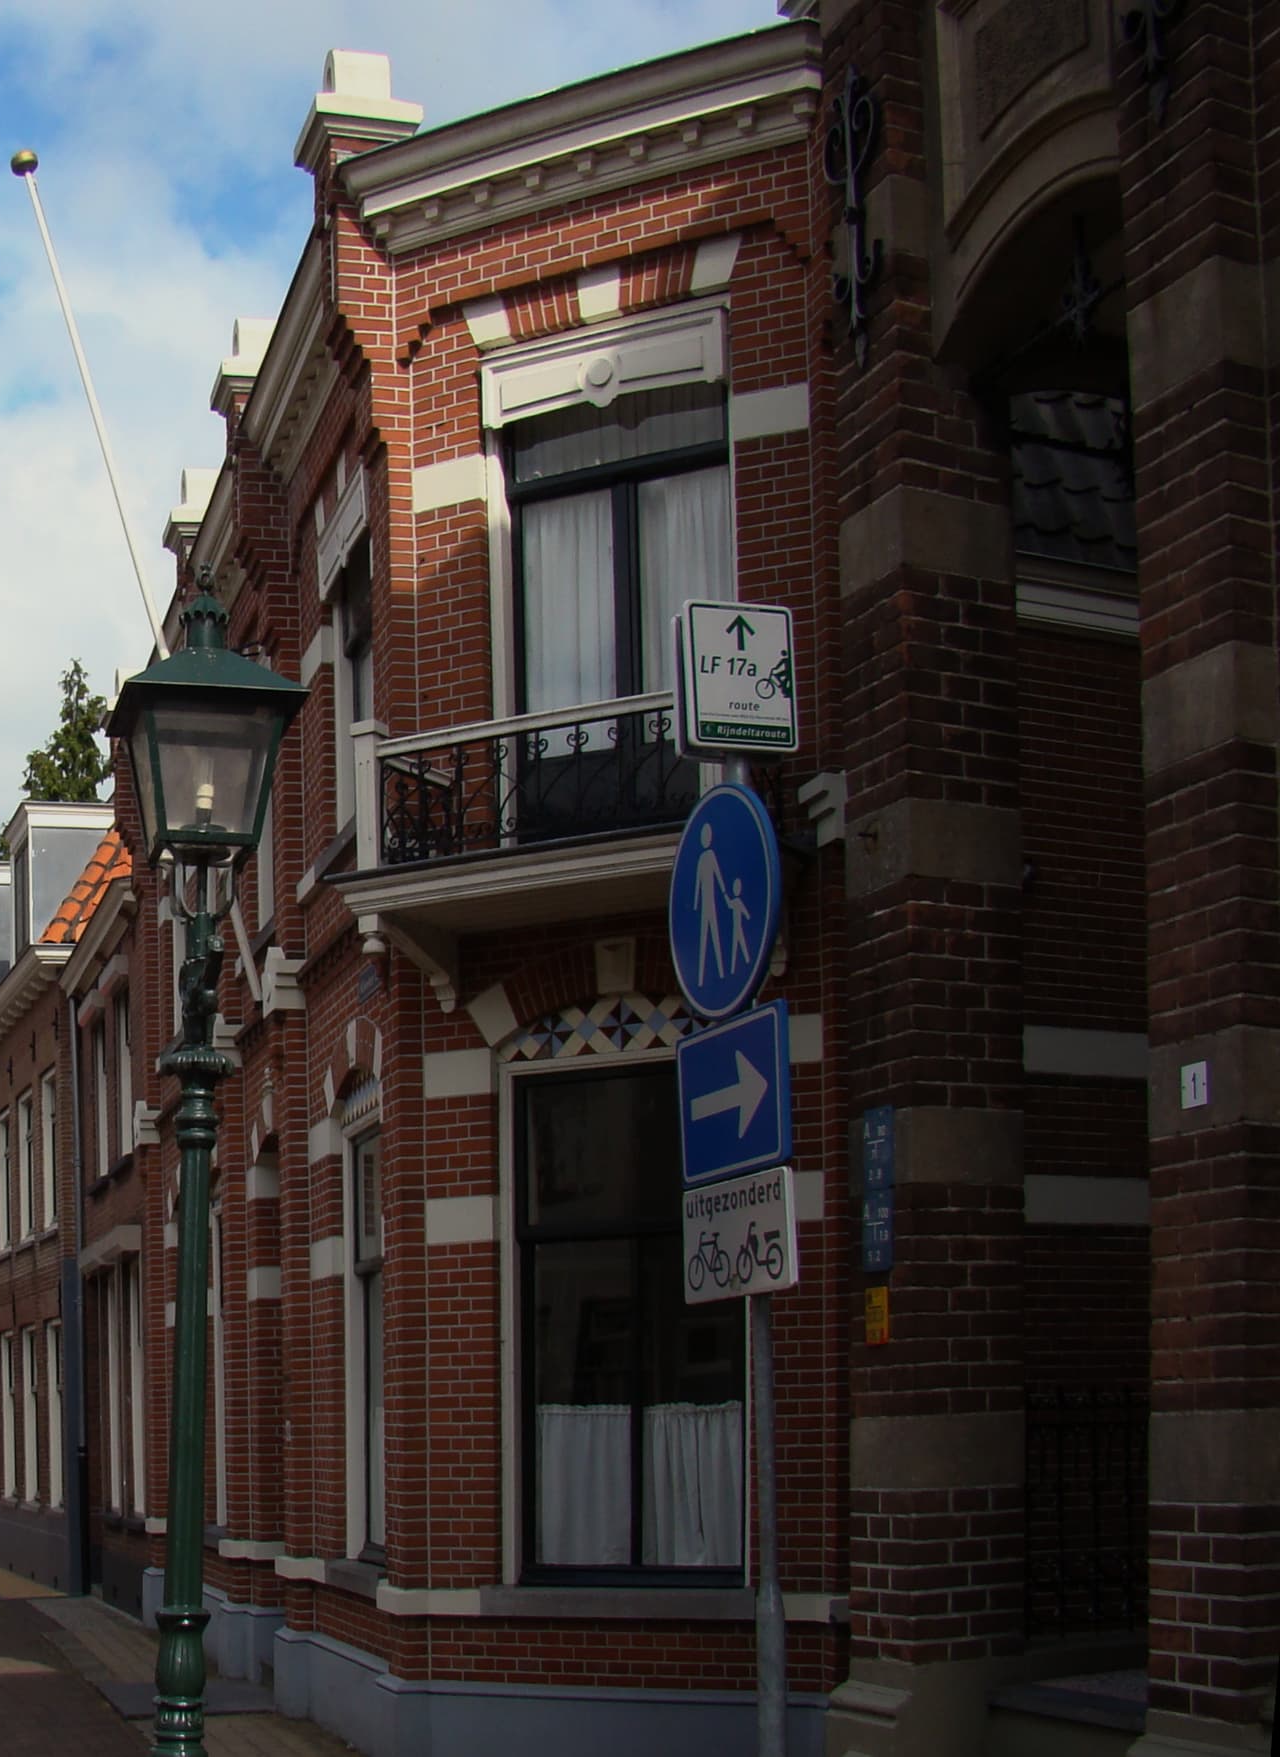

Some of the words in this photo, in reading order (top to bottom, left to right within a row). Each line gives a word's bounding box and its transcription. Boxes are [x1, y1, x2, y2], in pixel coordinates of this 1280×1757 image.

[700, 655, 721, 674] LF
[726, 657, 757, 677] 17a
[729, 701, 760, 711] route
[717, 725, 787, 739] Rijndeltaroute
[1191, 1071, 1197, 1100] 1
[686, 1175, 781, 1222] uitgezonderd
